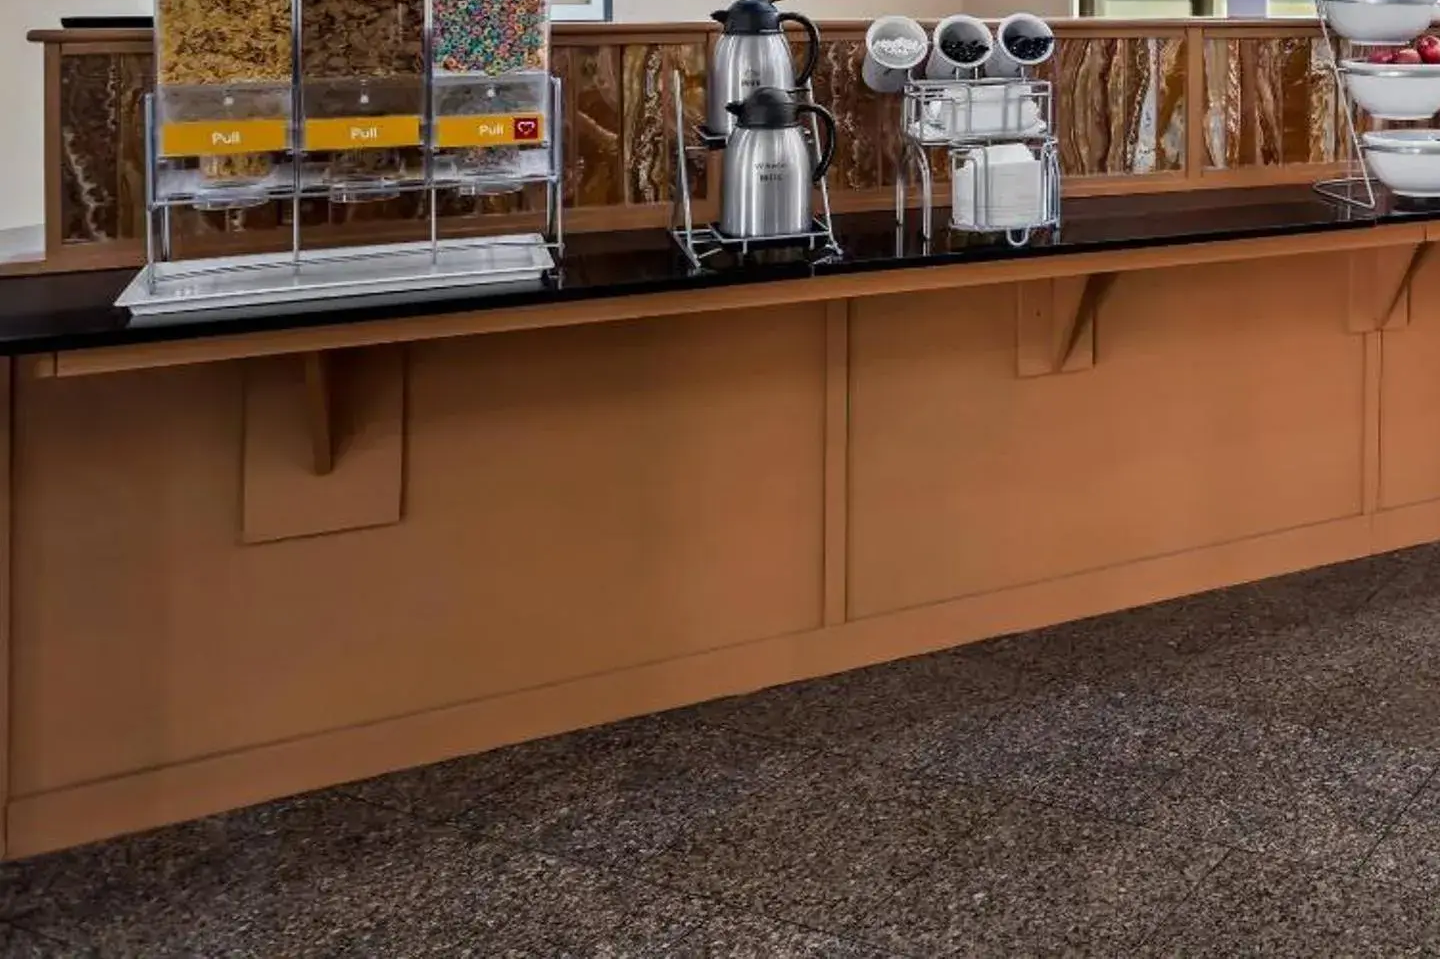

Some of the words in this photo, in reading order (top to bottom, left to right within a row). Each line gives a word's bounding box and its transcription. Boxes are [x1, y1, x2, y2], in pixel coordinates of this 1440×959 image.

[351, 126, 377, 140] Pull
[479, 123, 504, 137] Pull
[212, 131, 240, 146] Pull
